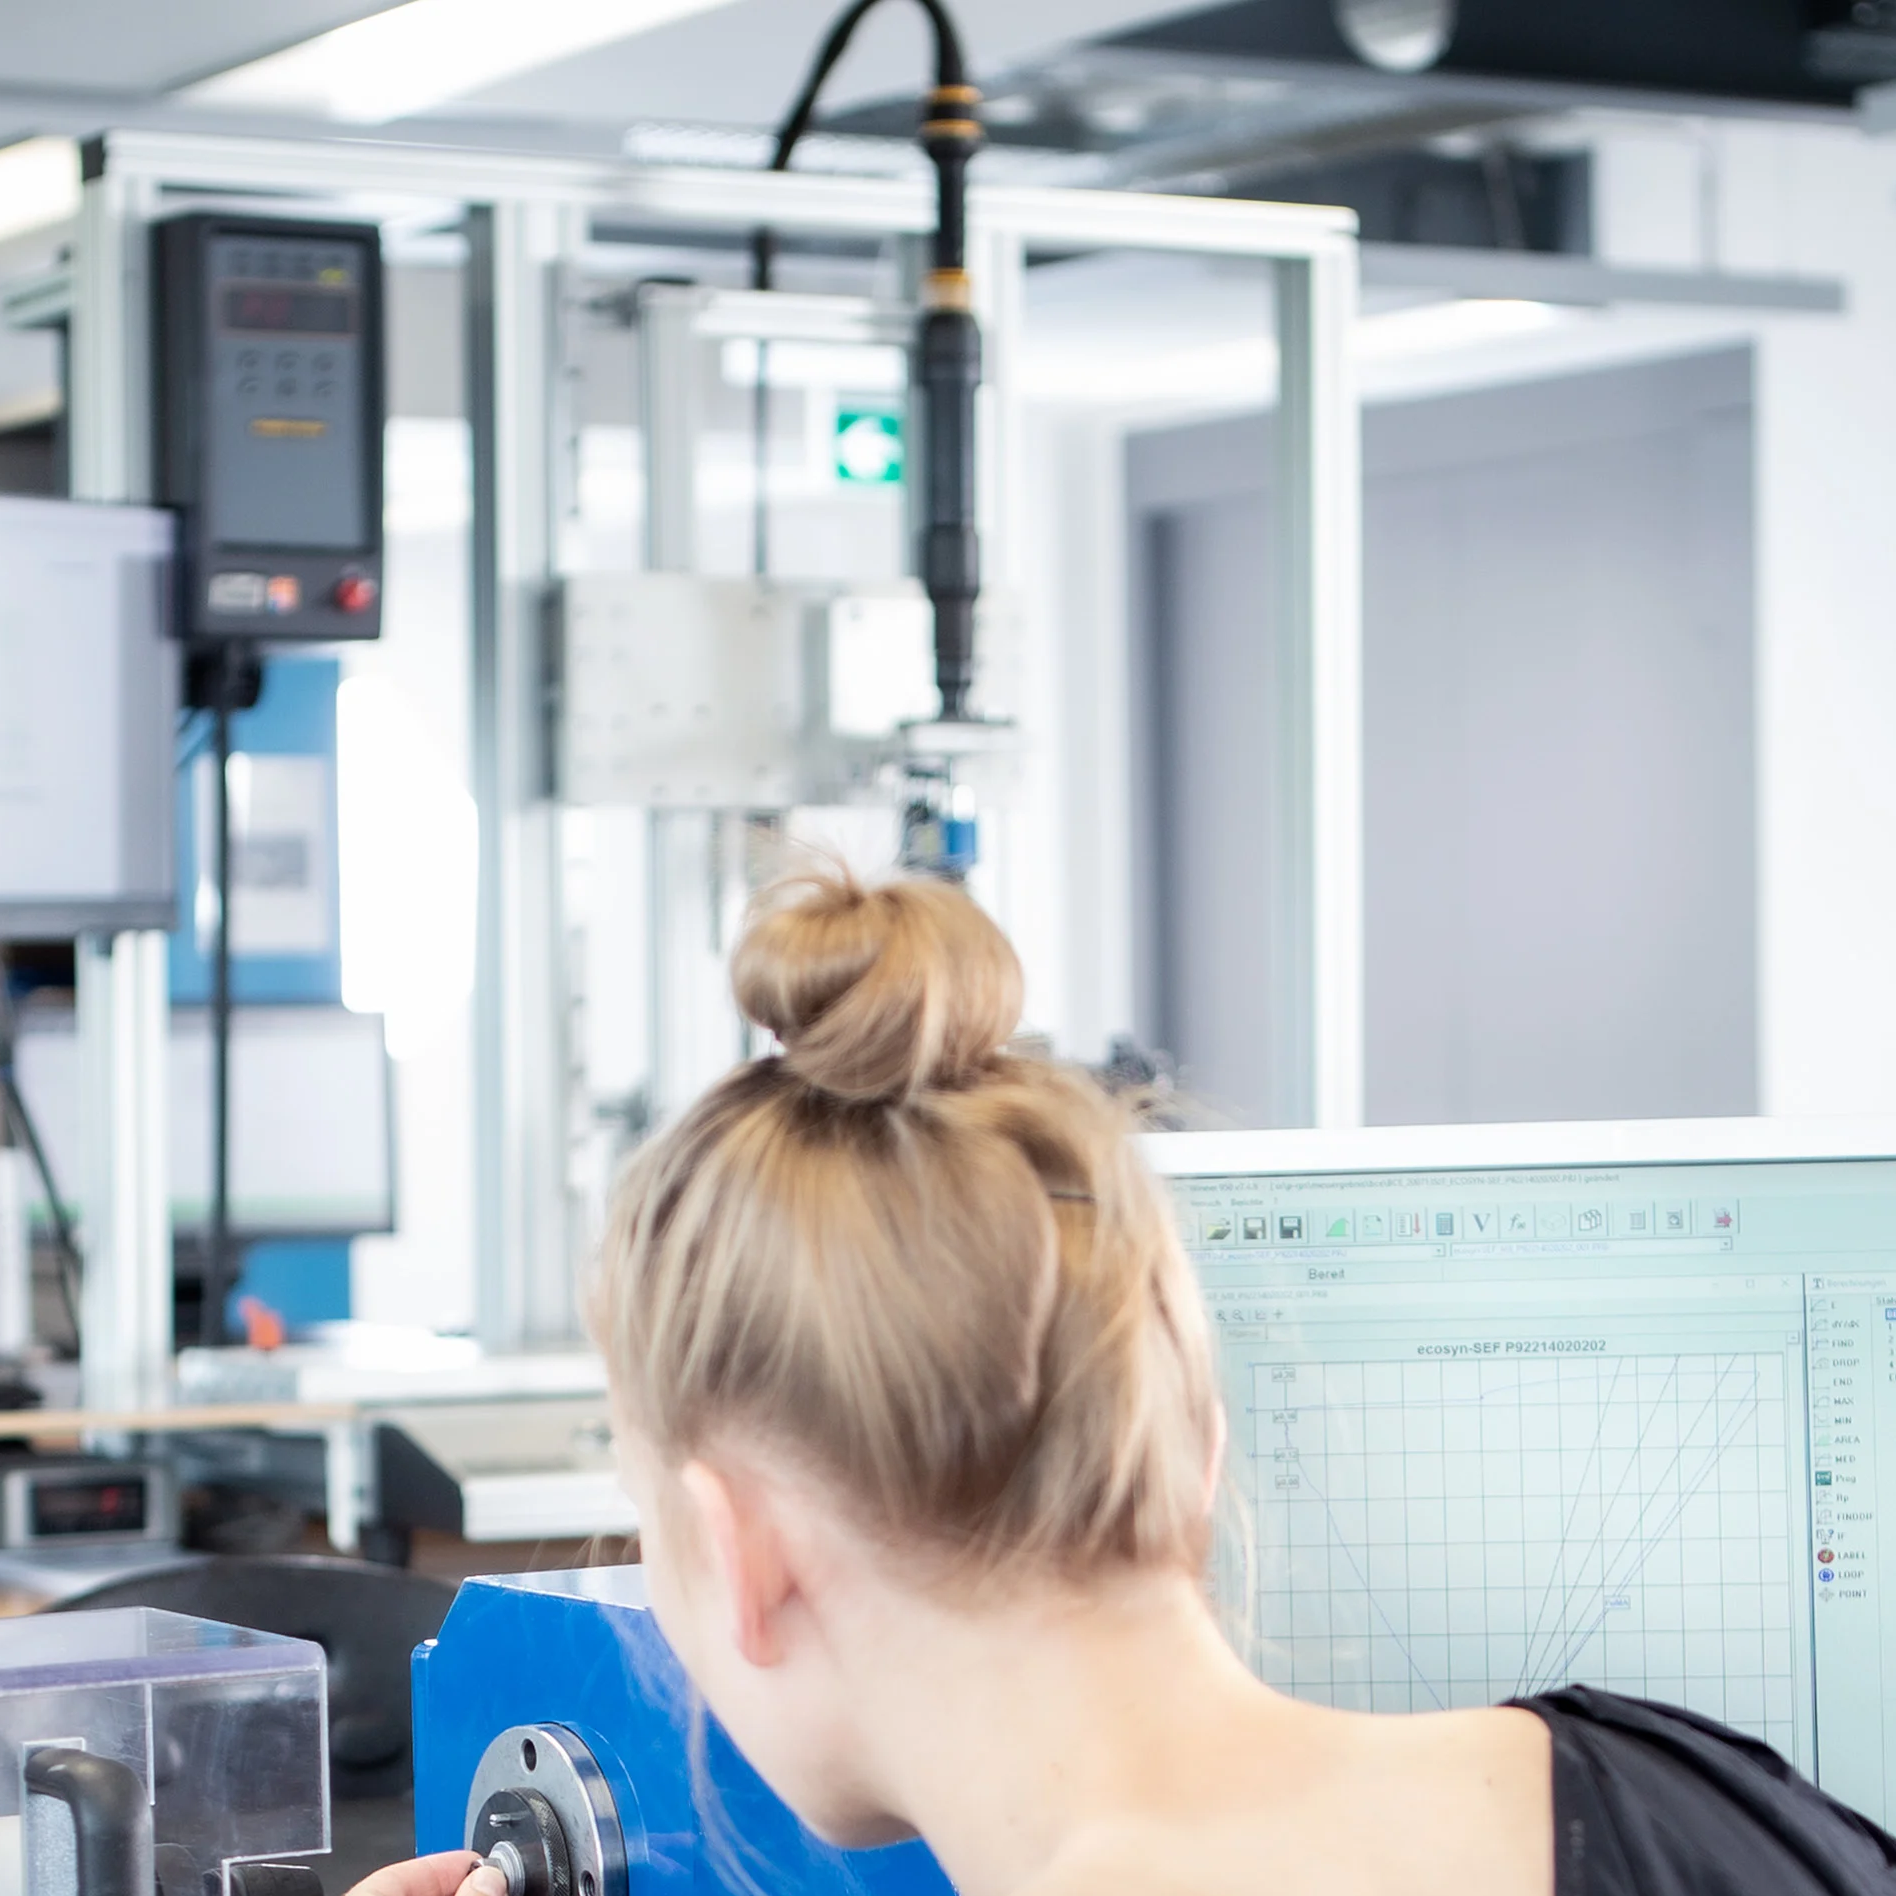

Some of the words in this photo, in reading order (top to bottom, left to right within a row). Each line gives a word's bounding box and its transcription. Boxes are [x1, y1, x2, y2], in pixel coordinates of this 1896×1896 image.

[1308, 1268, 1345, 1280] Bereit
[1416, 1341, 1501, 1358] ecosyn-SEF
[1505, 1338, 1607, 1353] P92214020202
[1831, 1340, 1855, 1348] FIND
[1832, 1358, 1860, 1368] DROP
[1833, 1377, 1853, 1387] END
[1833, 1396, 1855, 1406] MAX
[1834, 1416, 1852, 1426] MIN
[1834, 1436, 1861, 1445] AREA
[1835, 1454, 1857, 1464] MED
[1835, 1474, 1857, 1484] Prog
[1837, 1552, 1866, 1560] LABEL
[1837, 1570, 1865, 1580] LOOP
[1839, 1590, 1868, 1599] POINT
